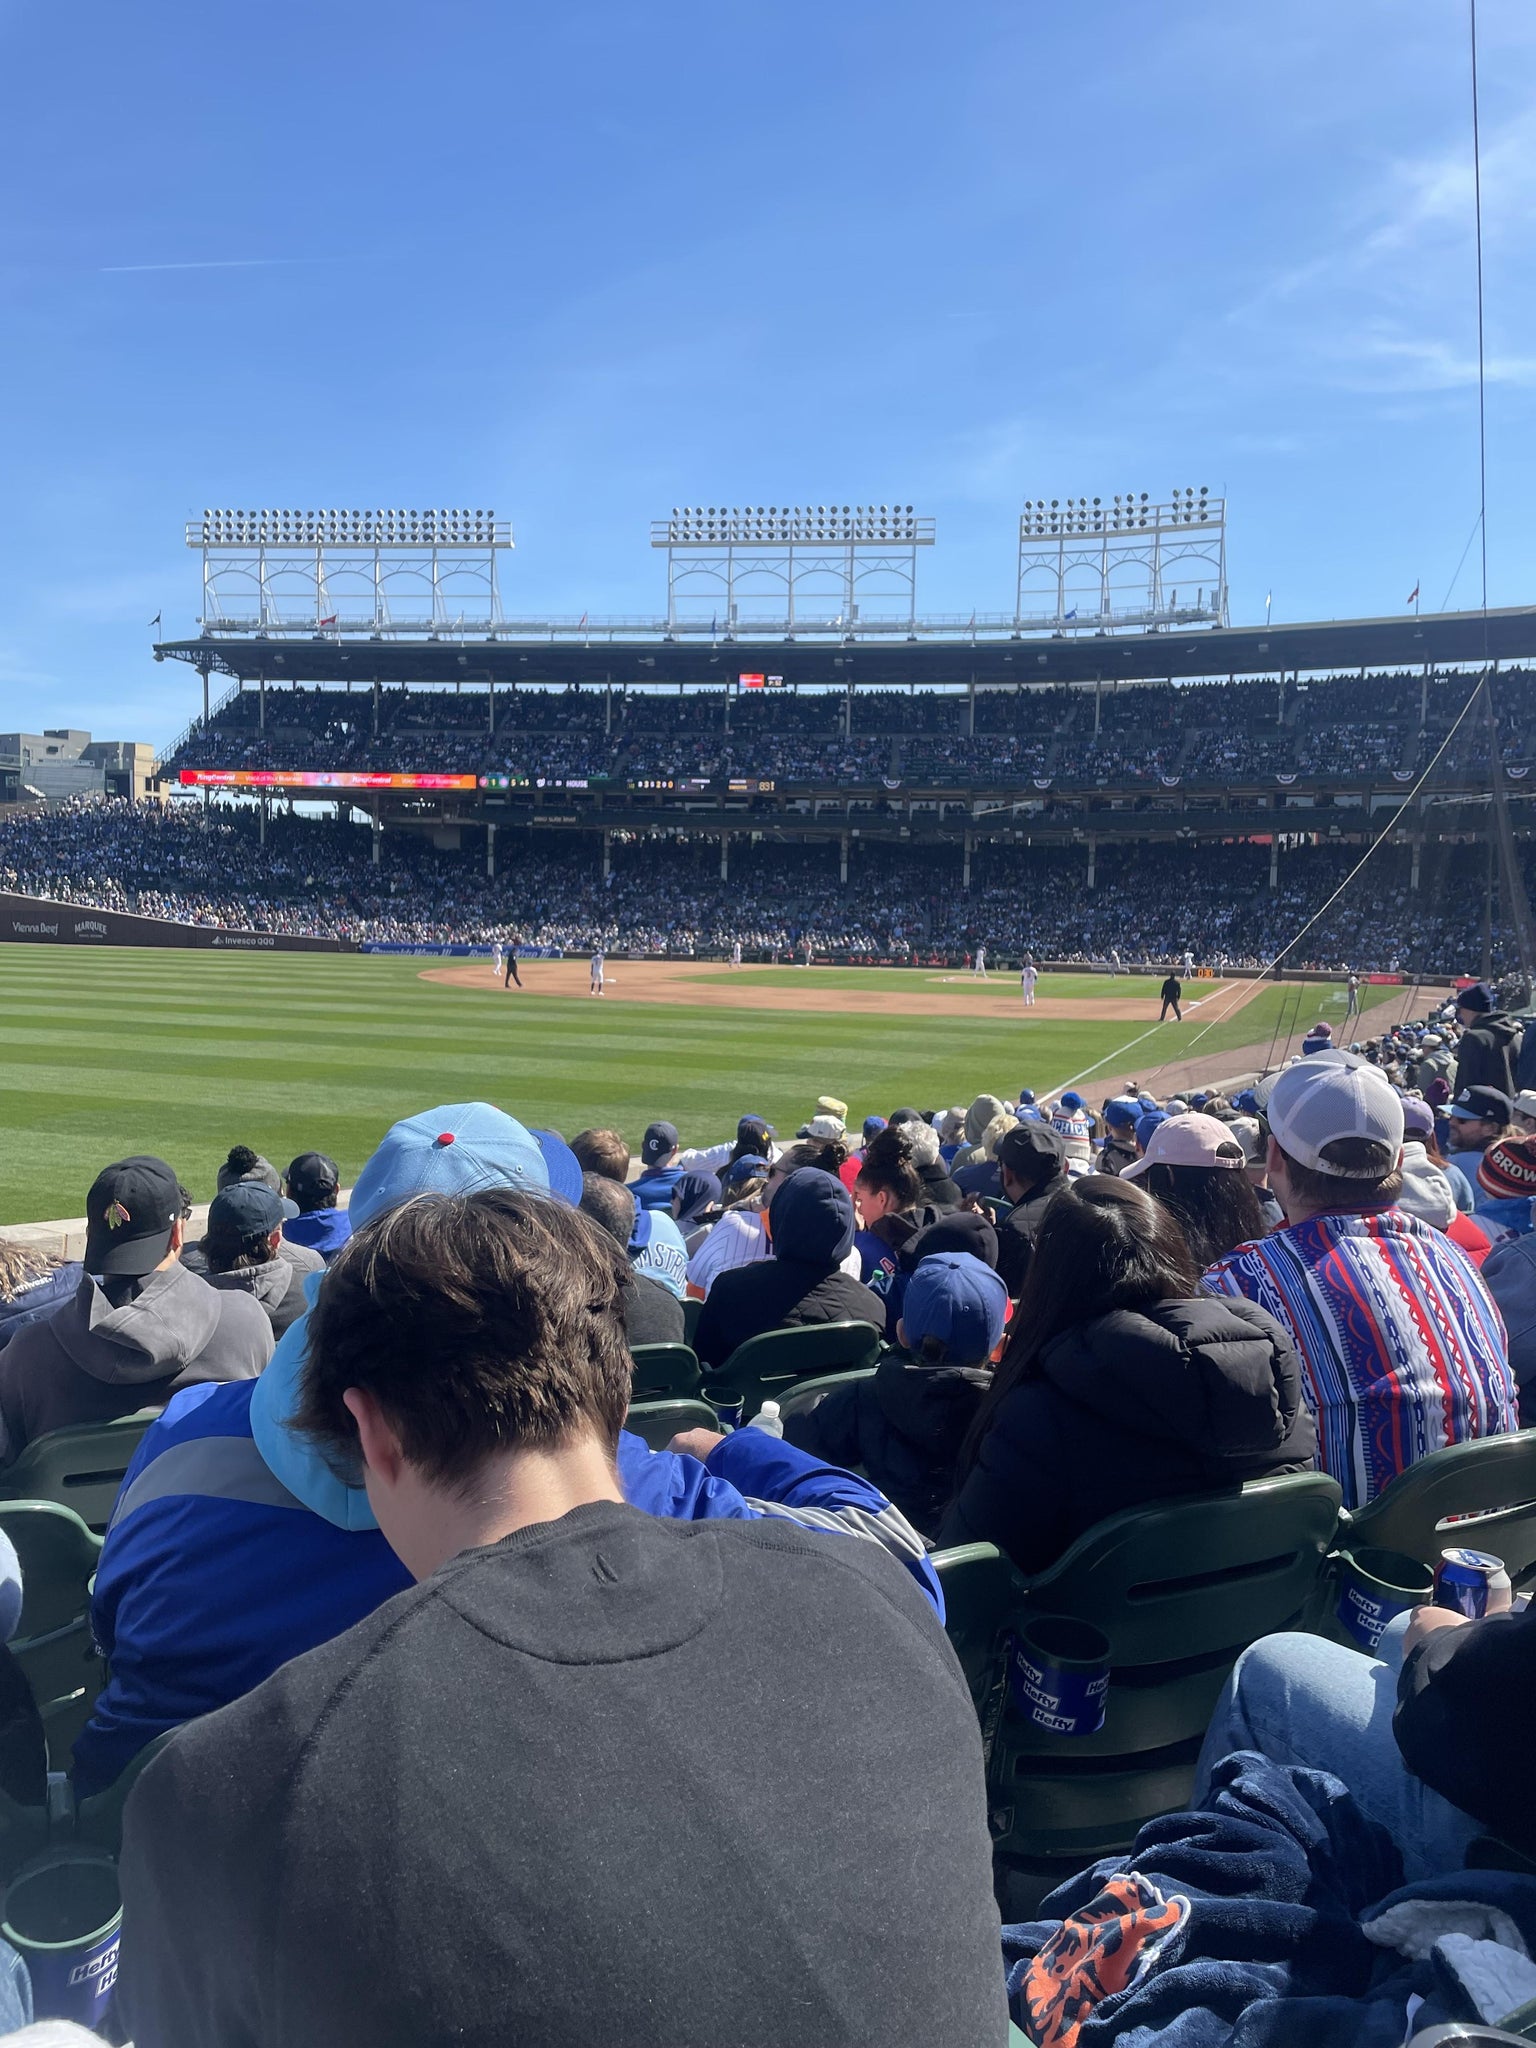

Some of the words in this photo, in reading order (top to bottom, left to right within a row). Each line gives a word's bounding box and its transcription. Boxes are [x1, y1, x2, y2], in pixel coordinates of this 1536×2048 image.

[197, 774, 235, 782] RingCentral
[352, 776, 392, 784] RingCentral
[12, 922, 39, 933] Vienna
[40, 922, 59, 936] Beef
[74, 921, 107, 935] MARQUEE
[225, 936, 256, 945] Invesco
[1350, 1590, 1378, 1613] Hefty
[1019, 1656, 1041, 1683] Hefty
[1024, 1683, 1058, 1709] Hefty
[1035, 1710, 1074, 1731] Hefty
[73, 1948, 119, 1981] Hefty
